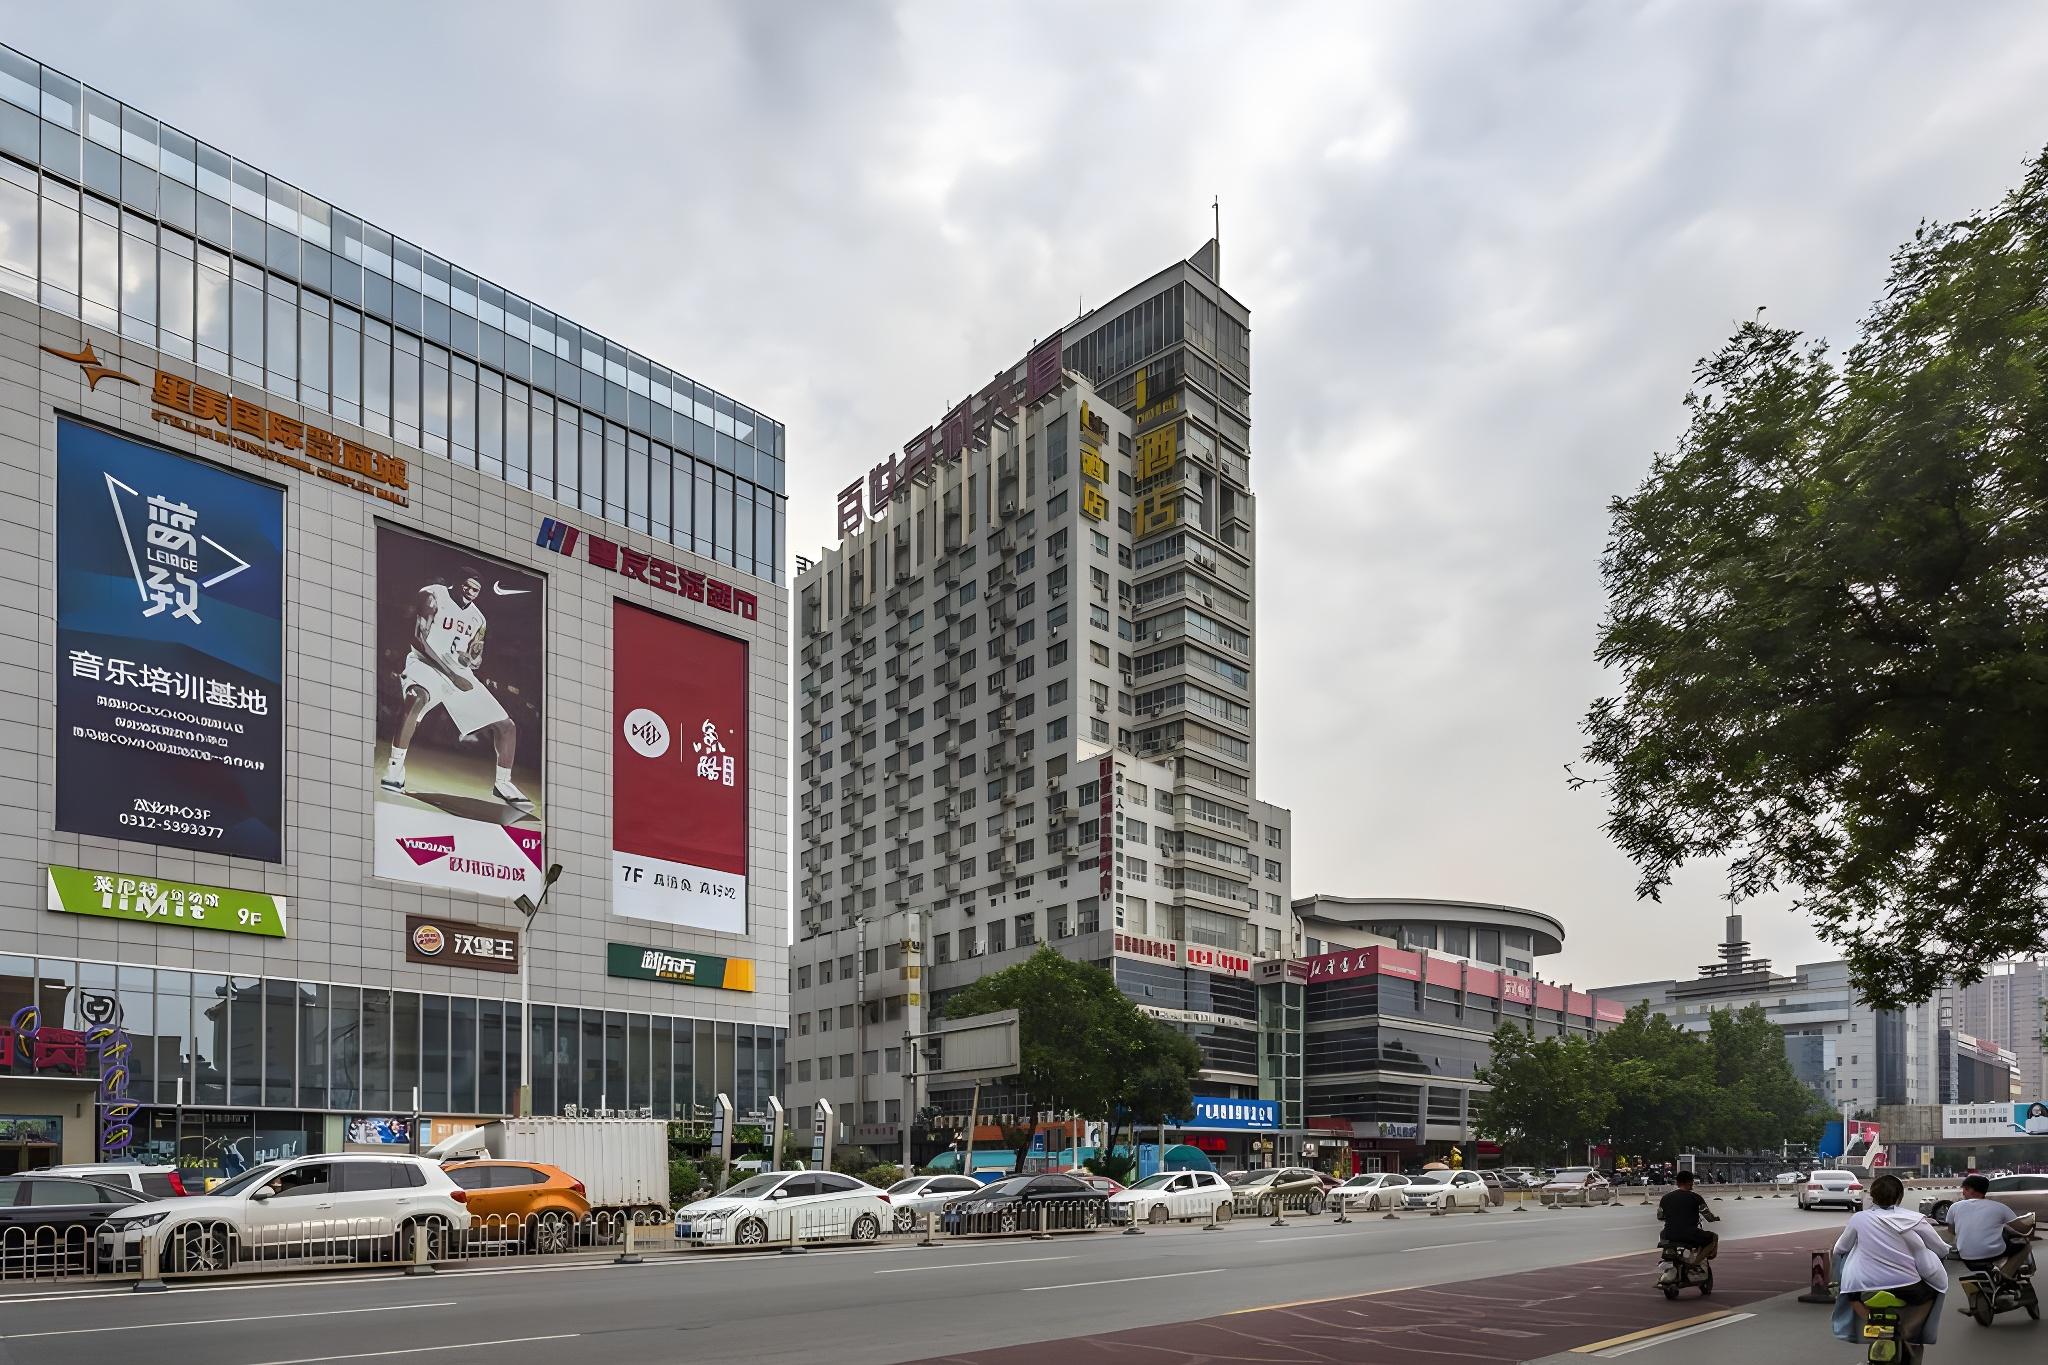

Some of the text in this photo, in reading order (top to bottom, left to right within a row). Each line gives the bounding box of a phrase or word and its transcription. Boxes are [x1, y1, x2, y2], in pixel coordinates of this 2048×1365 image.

[68, 650, 268, 716] 音乐培训基地
[621, 865, 644, 884] 7F
[237, 908, 263, 927] 9F
